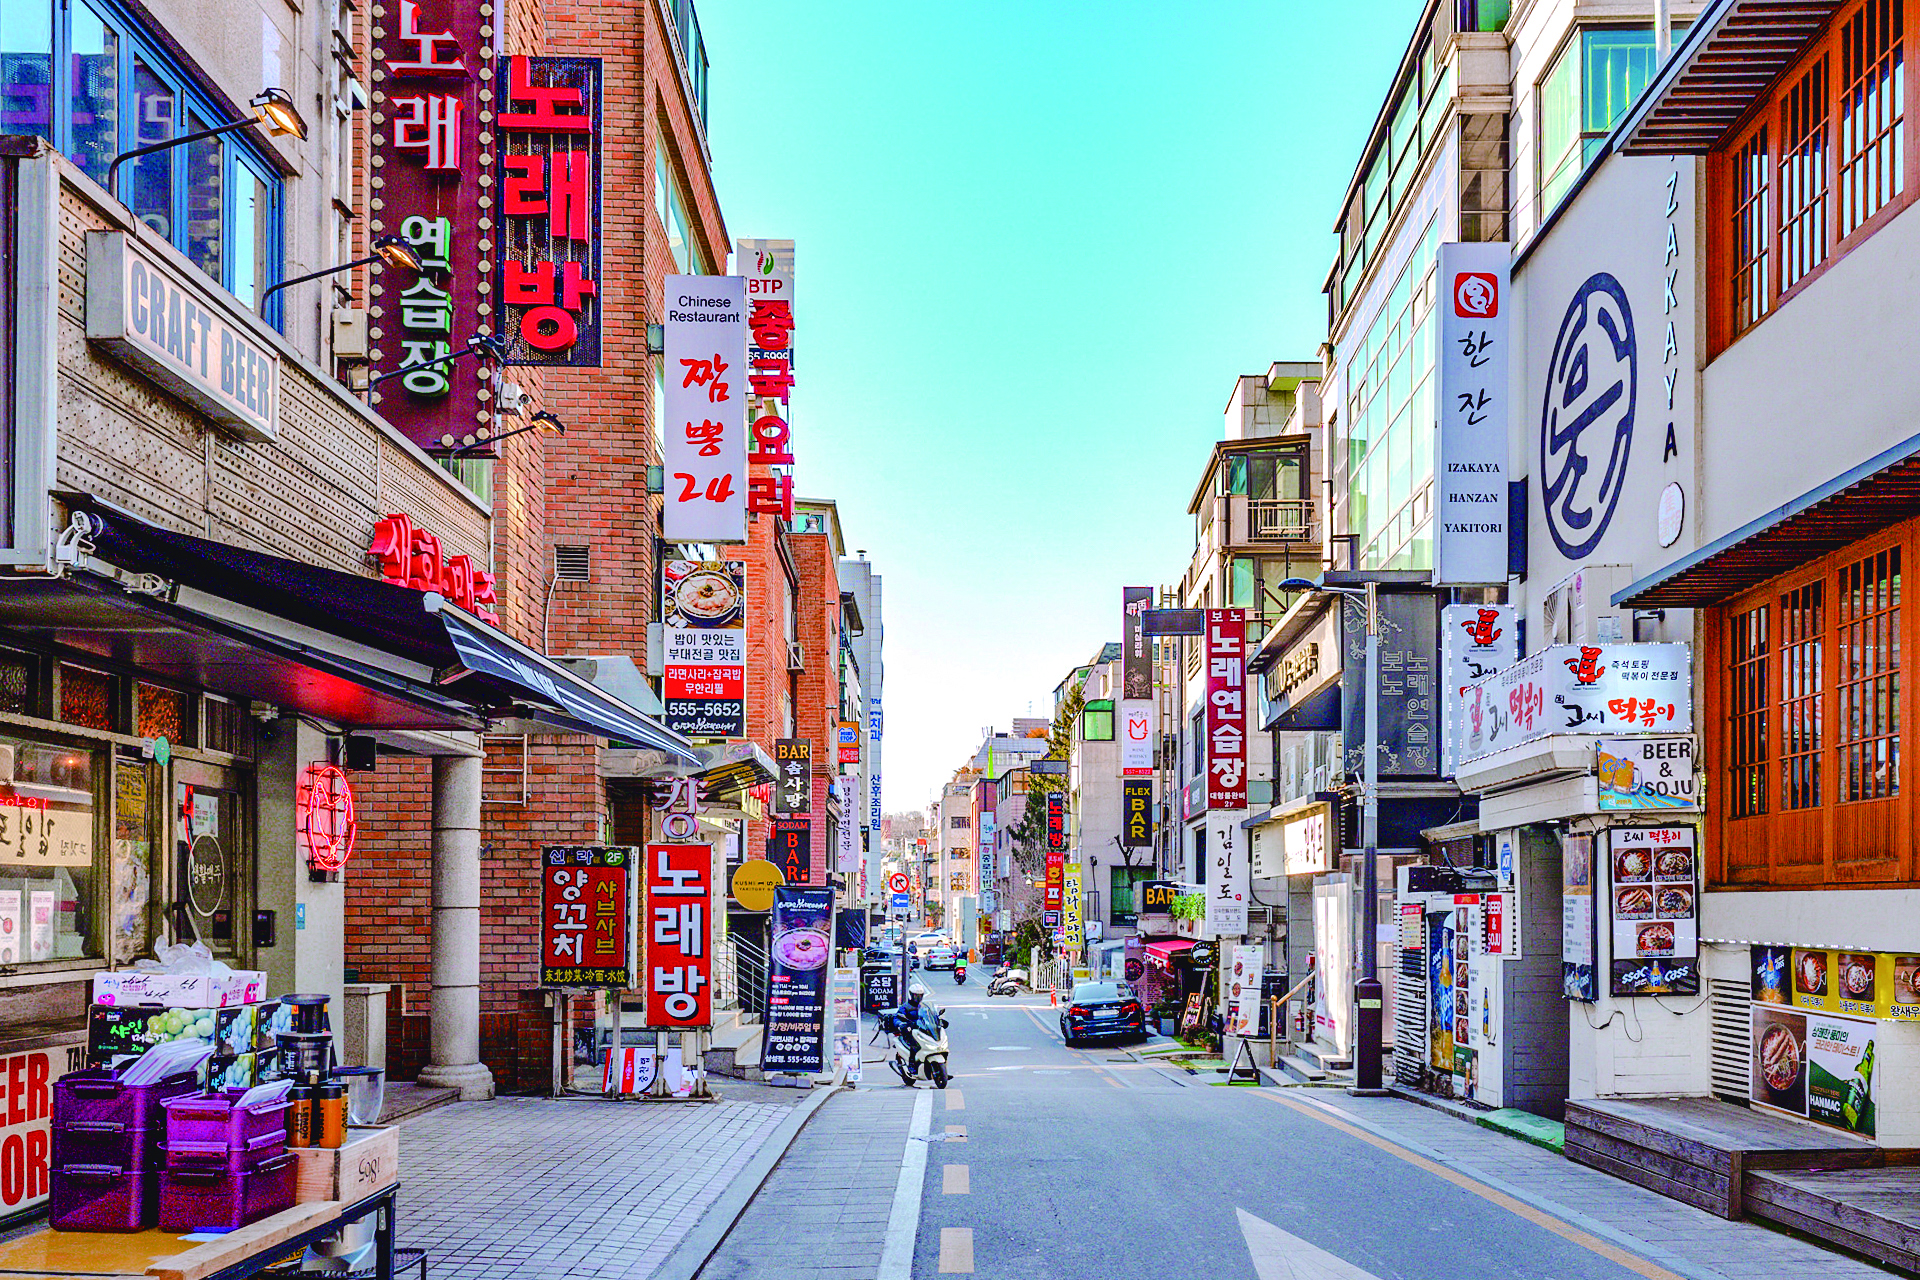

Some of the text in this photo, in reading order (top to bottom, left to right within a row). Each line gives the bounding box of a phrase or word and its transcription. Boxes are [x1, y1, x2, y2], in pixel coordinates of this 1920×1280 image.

[498, 54, 597, 353] 노래방
[749, 279, 783, 293] BTP
[400, 214, 454, 398] 연습장
[678, 295, 731, 308] Chinese
[669, 311, 740, 323] Restaurant
[129, 259, 271, 421] CRAFT BEER
[1448, 463, 1500, 474] IZAKAYA
[1449, 493, 1498, 504] HANZAN
[1444, 523, 1502, 534] YAKITORI
[701, 633, 735, 646] 맛있는
[668, 649, 741, 661] 부대전골 맛집
[1611, 660, 1649, 669] 즉석 토핑
[1621, 671, 1678, 681] 떡볶이 전문점
[685, 682, 724, 695] 무한리필
[669, 702, 741, 717] 555-5652
[1211, 626, 1244, 788] 노래연습장
[1407, 650, 1429, 768] 노래연습장
[1509, 682, 1543, 731] 떡볶이
[1562, 697, 1675, 727] 고씨 떡볶이
[870, 718, 881, 741] 치과
[778, 745, 809, 760] BAR
[1643, 743, 1691, 759] BEER
[1659, 761, 1673, 778] &
[1125, 787, 1150, 796] FLEX
[1644, 780, 1692, 796] SOJU
[870, 774, 882, 830] 산후조리원
[777, 821, 808, 830] SODAM
[1049, 801, 1063, 847] 노래방
[1130, 798, 1146, 838] BAR
[1623, 829, 1681, 844] 고씨 떡볶이
[607, 852, 621, 863] 2F
[786, 832, 800, 881] BAR
[1216, 824, 1234, 899] 김일도
[1146, 888, 1176, 905] BAR
[1065, 878, 1079, 943] 탐라도야지
[1487, 901, 1502, 915] BEER
[552, 868, 589, 965] 양꼬치
[650, 851, 705, 1018] 노래방
[870, 977, 892, 988] 소담
[1890, 1005, 1920, 1018] 왕새우
[110, 1019, 142, 1039] 샤인
[1809, 1094, 1841, 1113] HANMAC
